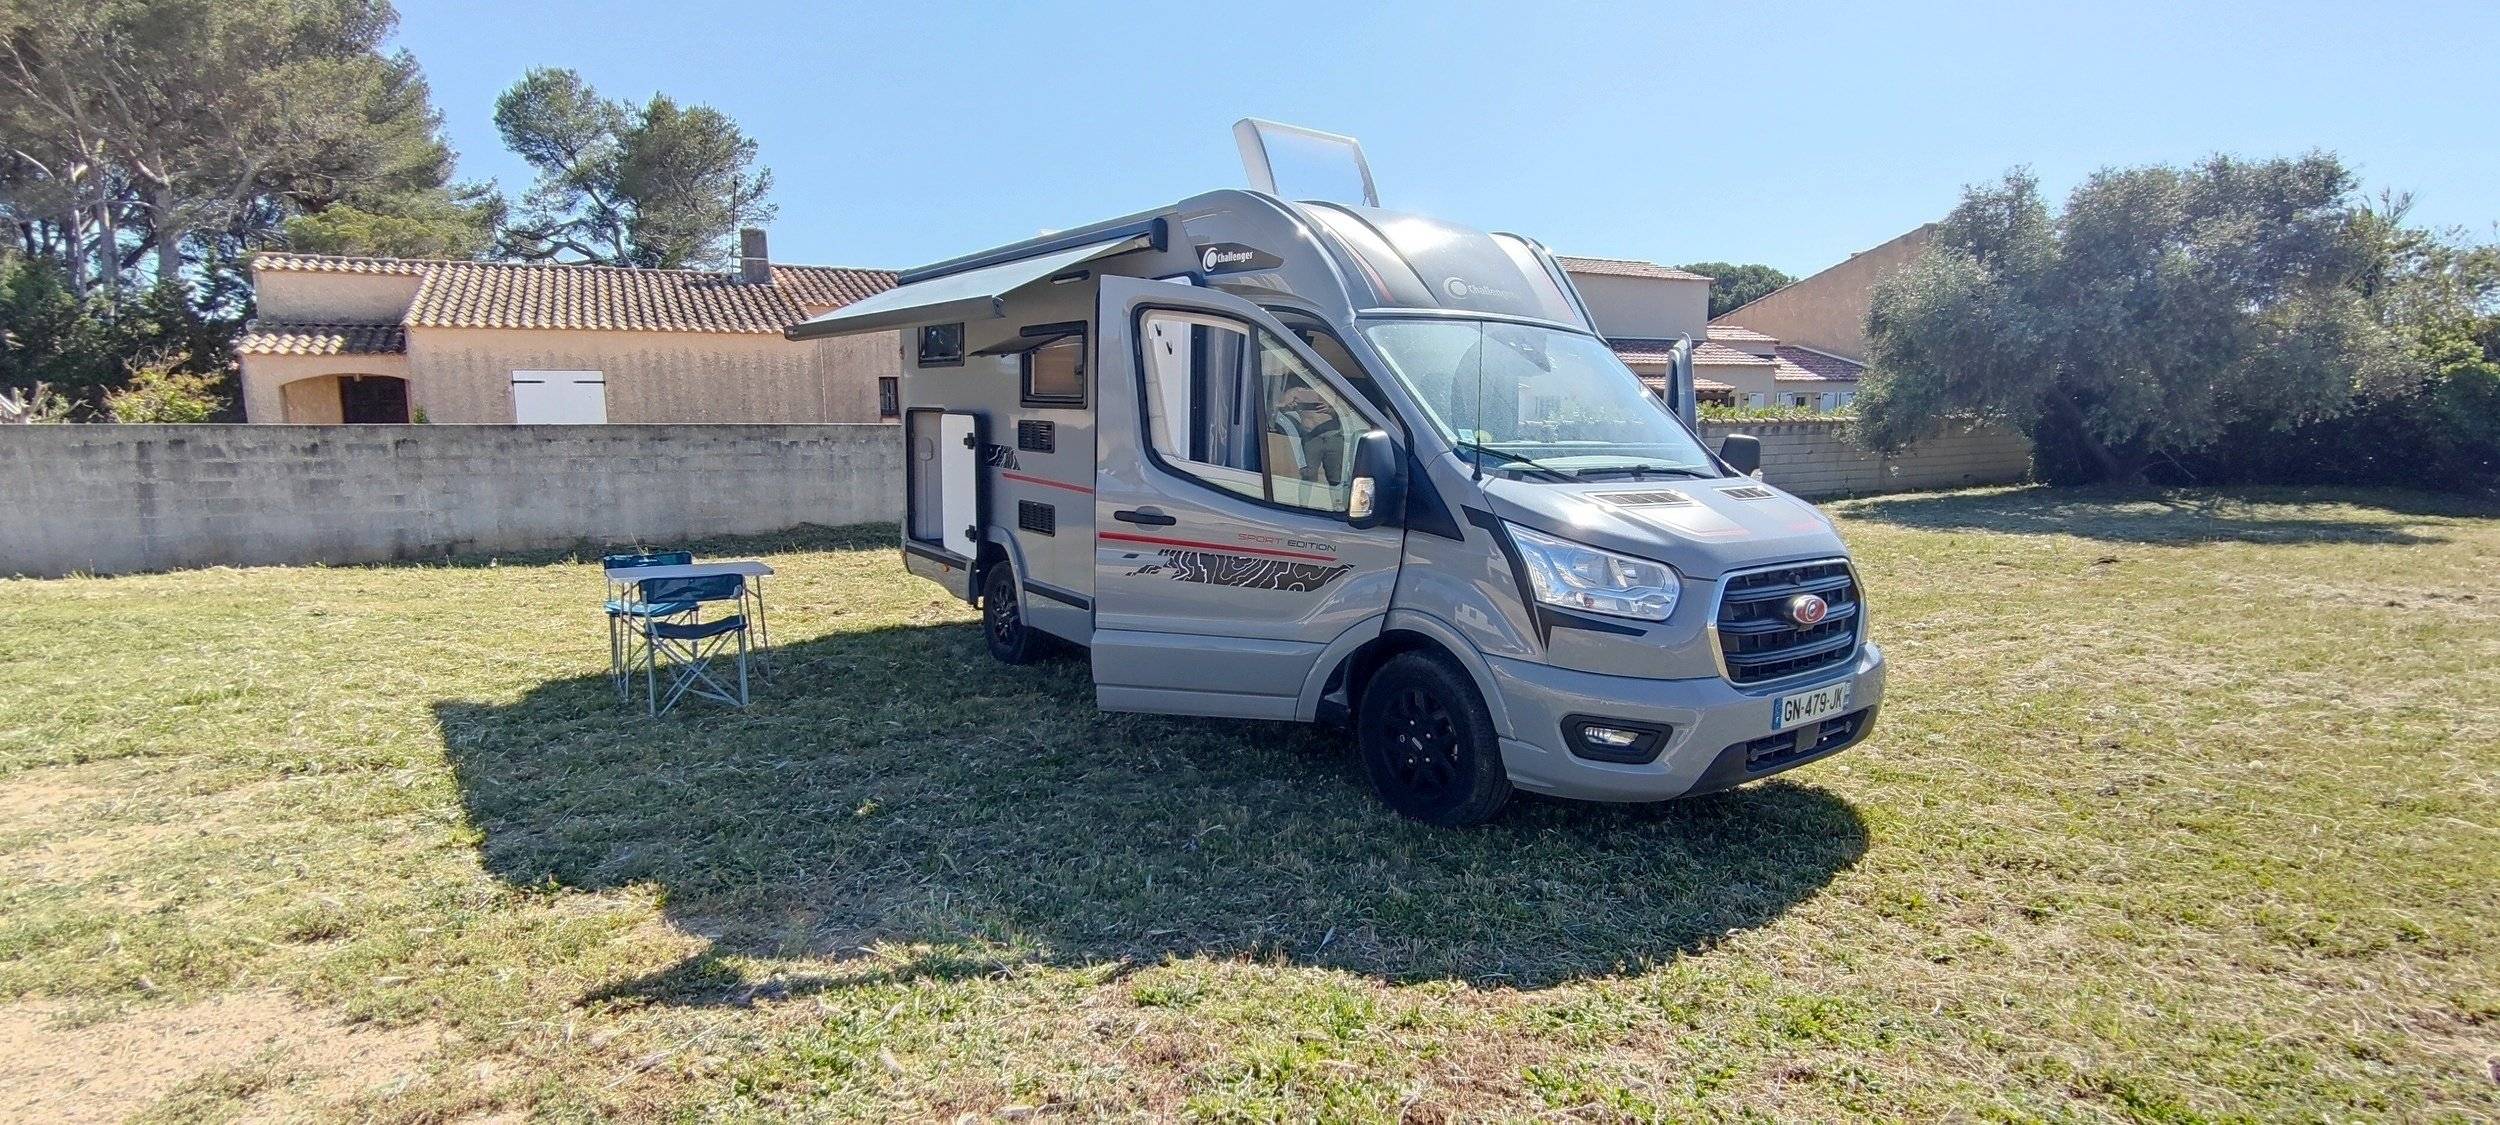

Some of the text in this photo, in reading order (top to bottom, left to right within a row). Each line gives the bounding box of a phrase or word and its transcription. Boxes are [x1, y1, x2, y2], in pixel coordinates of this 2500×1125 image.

[1217, 251, 1253, 263] Challenger
[1238, 532, 1337, 552] SPORT EDITION
[1784, 687, 1843, 721] GN-479-JK
